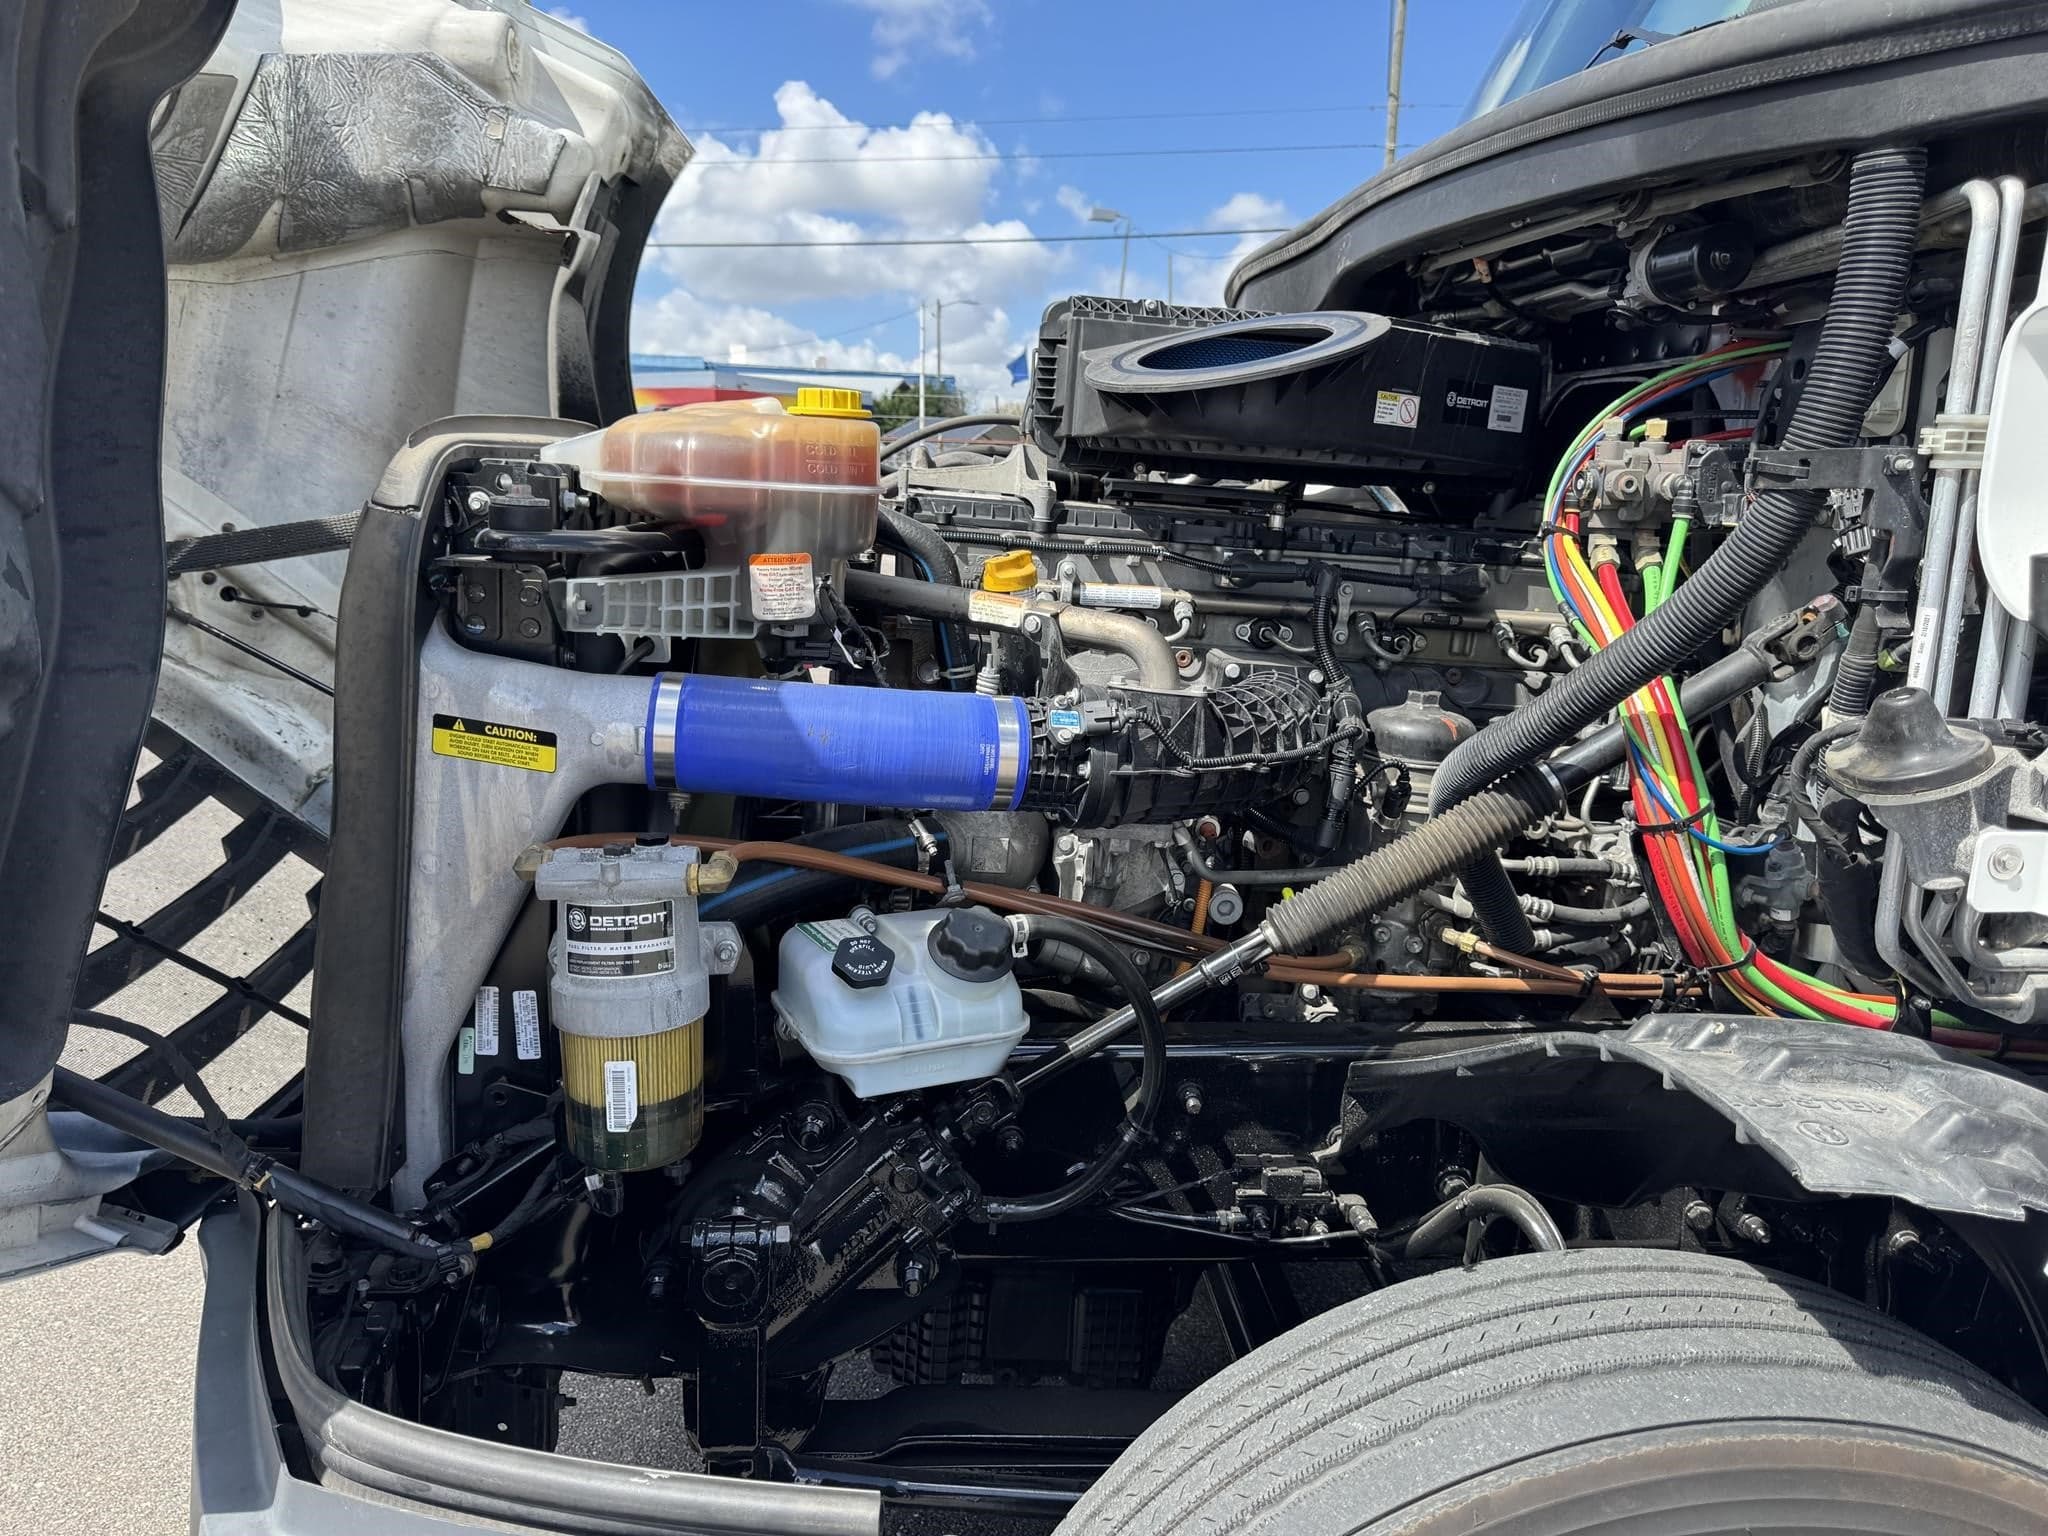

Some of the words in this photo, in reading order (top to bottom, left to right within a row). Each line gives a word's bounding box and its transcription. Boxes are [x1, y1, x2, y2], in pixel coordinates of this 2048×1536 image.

[1456, 396, 1489, 408] DETROIT
[807, 445, 837, 456] COLD
[808, 464, 837, 473] COLD
[485, 725, 537, 742] CAUTION:
[589, 912, 667, 926] DETROIT
[635, 941, 671, 949] SEPARATOR
[849, 944, 876, 953] OVERFILL
